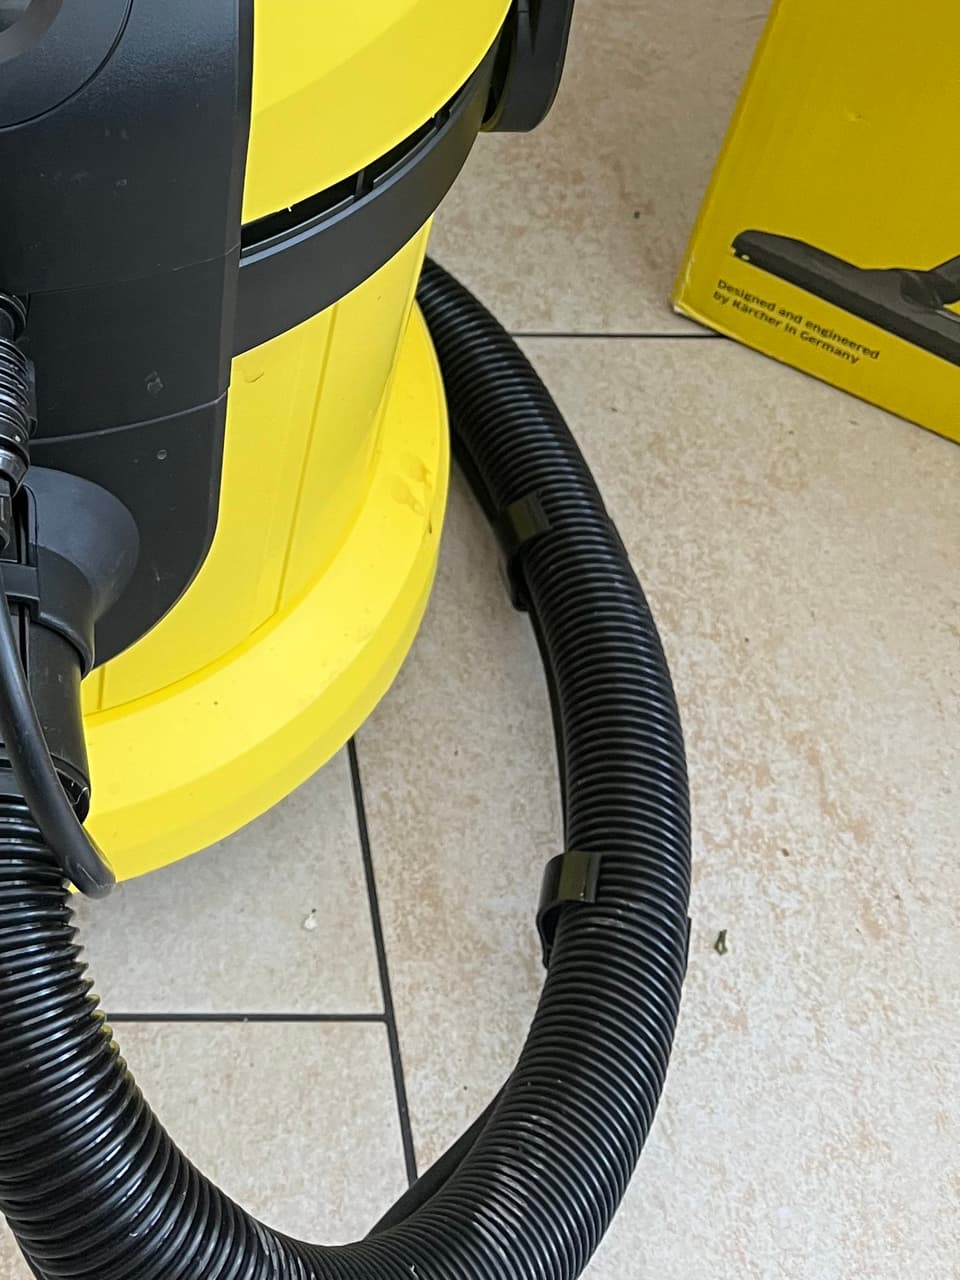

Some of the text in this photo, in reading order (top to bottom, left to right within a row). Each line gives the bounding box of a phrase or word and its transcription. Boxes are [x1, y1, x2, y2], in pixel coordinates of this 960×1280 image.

[712, 290, 729, 305] by
[786, 323, 797, 336] in
[800, 331, 861, 365] Germany
[717, 279, 881, 360] Designed and engineered
